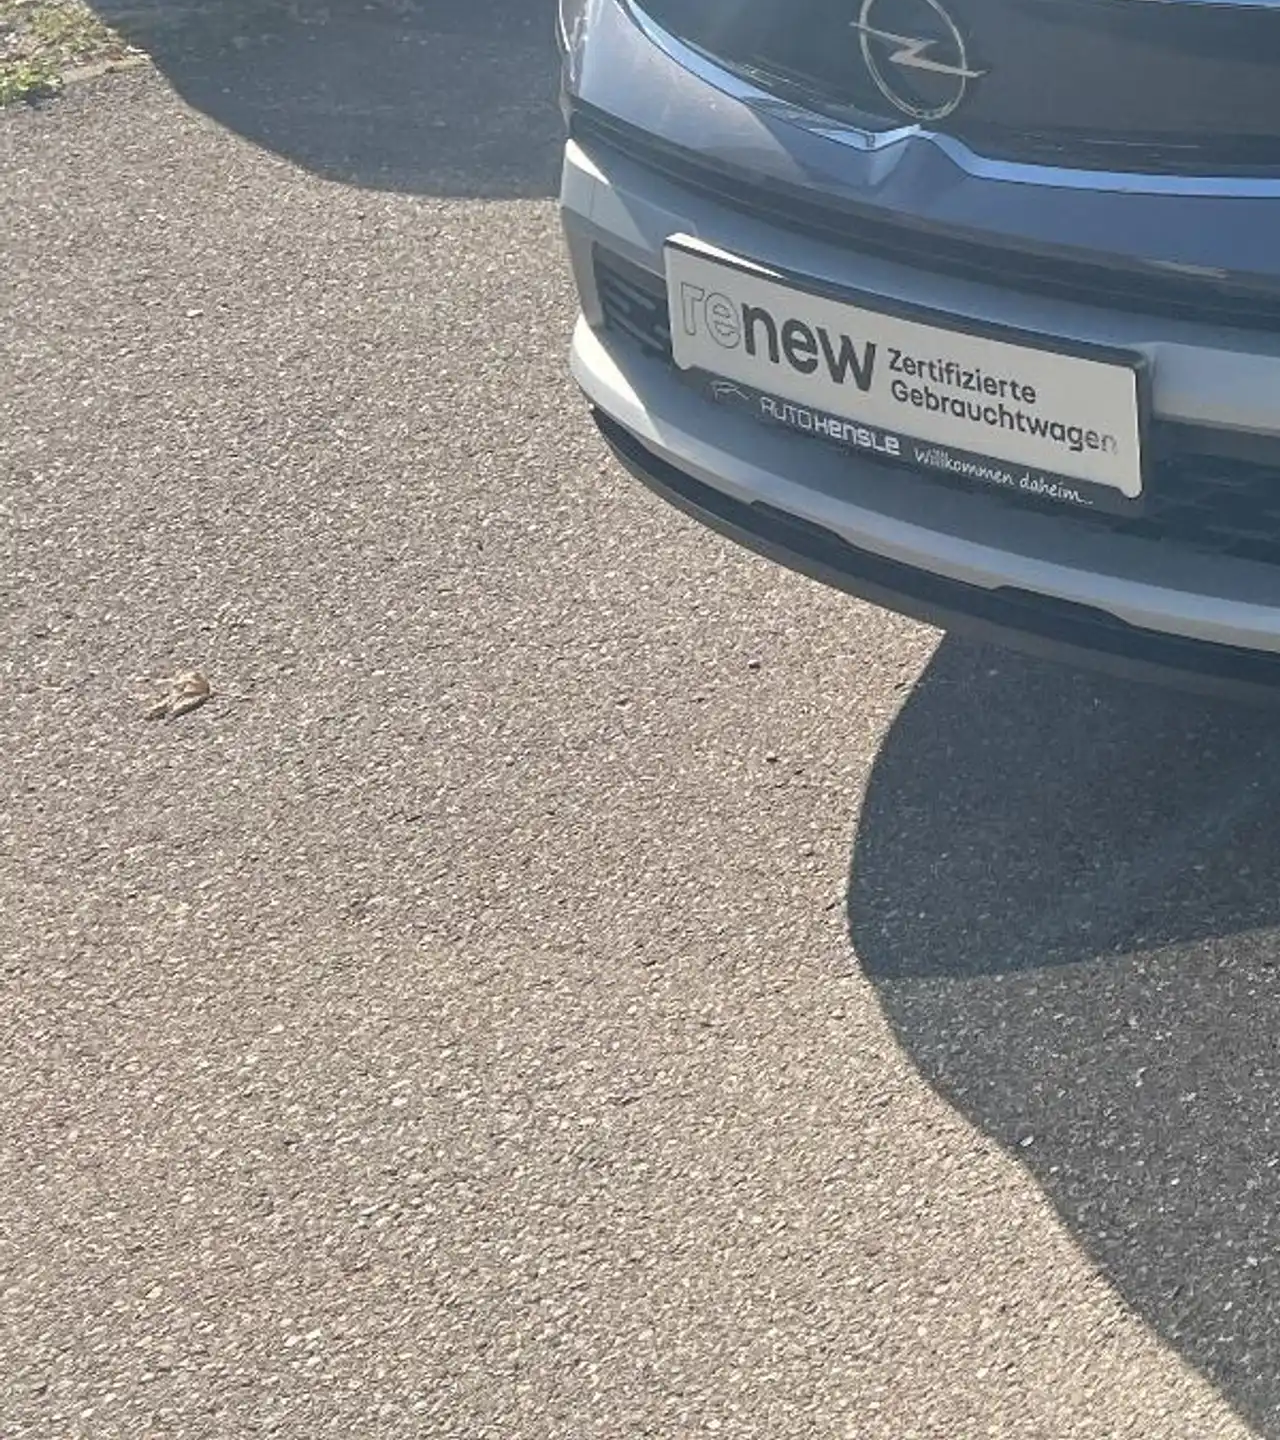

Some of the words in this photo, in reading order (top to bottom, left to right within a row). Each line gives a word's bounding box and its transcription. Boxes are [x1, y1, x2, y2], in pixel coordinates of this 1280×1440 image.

[681, 282, 877, 392] renew
[888, 348, 1036, 405] Zertifizierte
[892, 380, 1118, 454] Gebrauchtwagen
